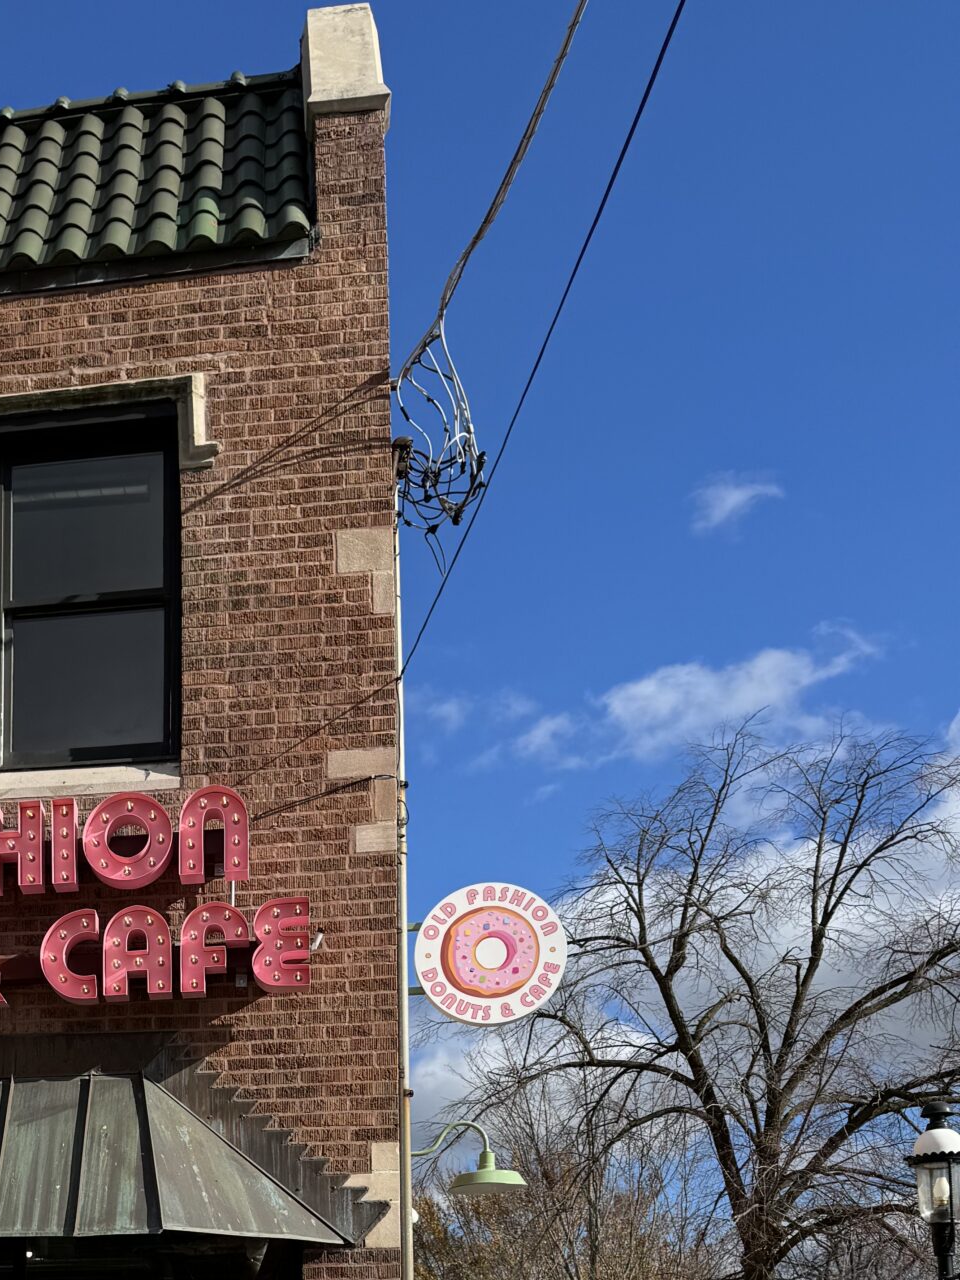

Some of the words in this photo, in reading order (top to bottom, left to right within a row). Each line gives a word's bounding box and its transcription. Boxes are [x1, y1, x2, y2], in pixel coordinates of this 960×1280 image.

[423, 902, 457, 940] OLD
[466, 886, 558, 936] FASHION
[40, 896, 310, 1005] CAFE
[421, 967, 491, 1021] DONUTS
[500, 1002, 516, 1018] &
[520, 962, 561, 1007] CAFE
